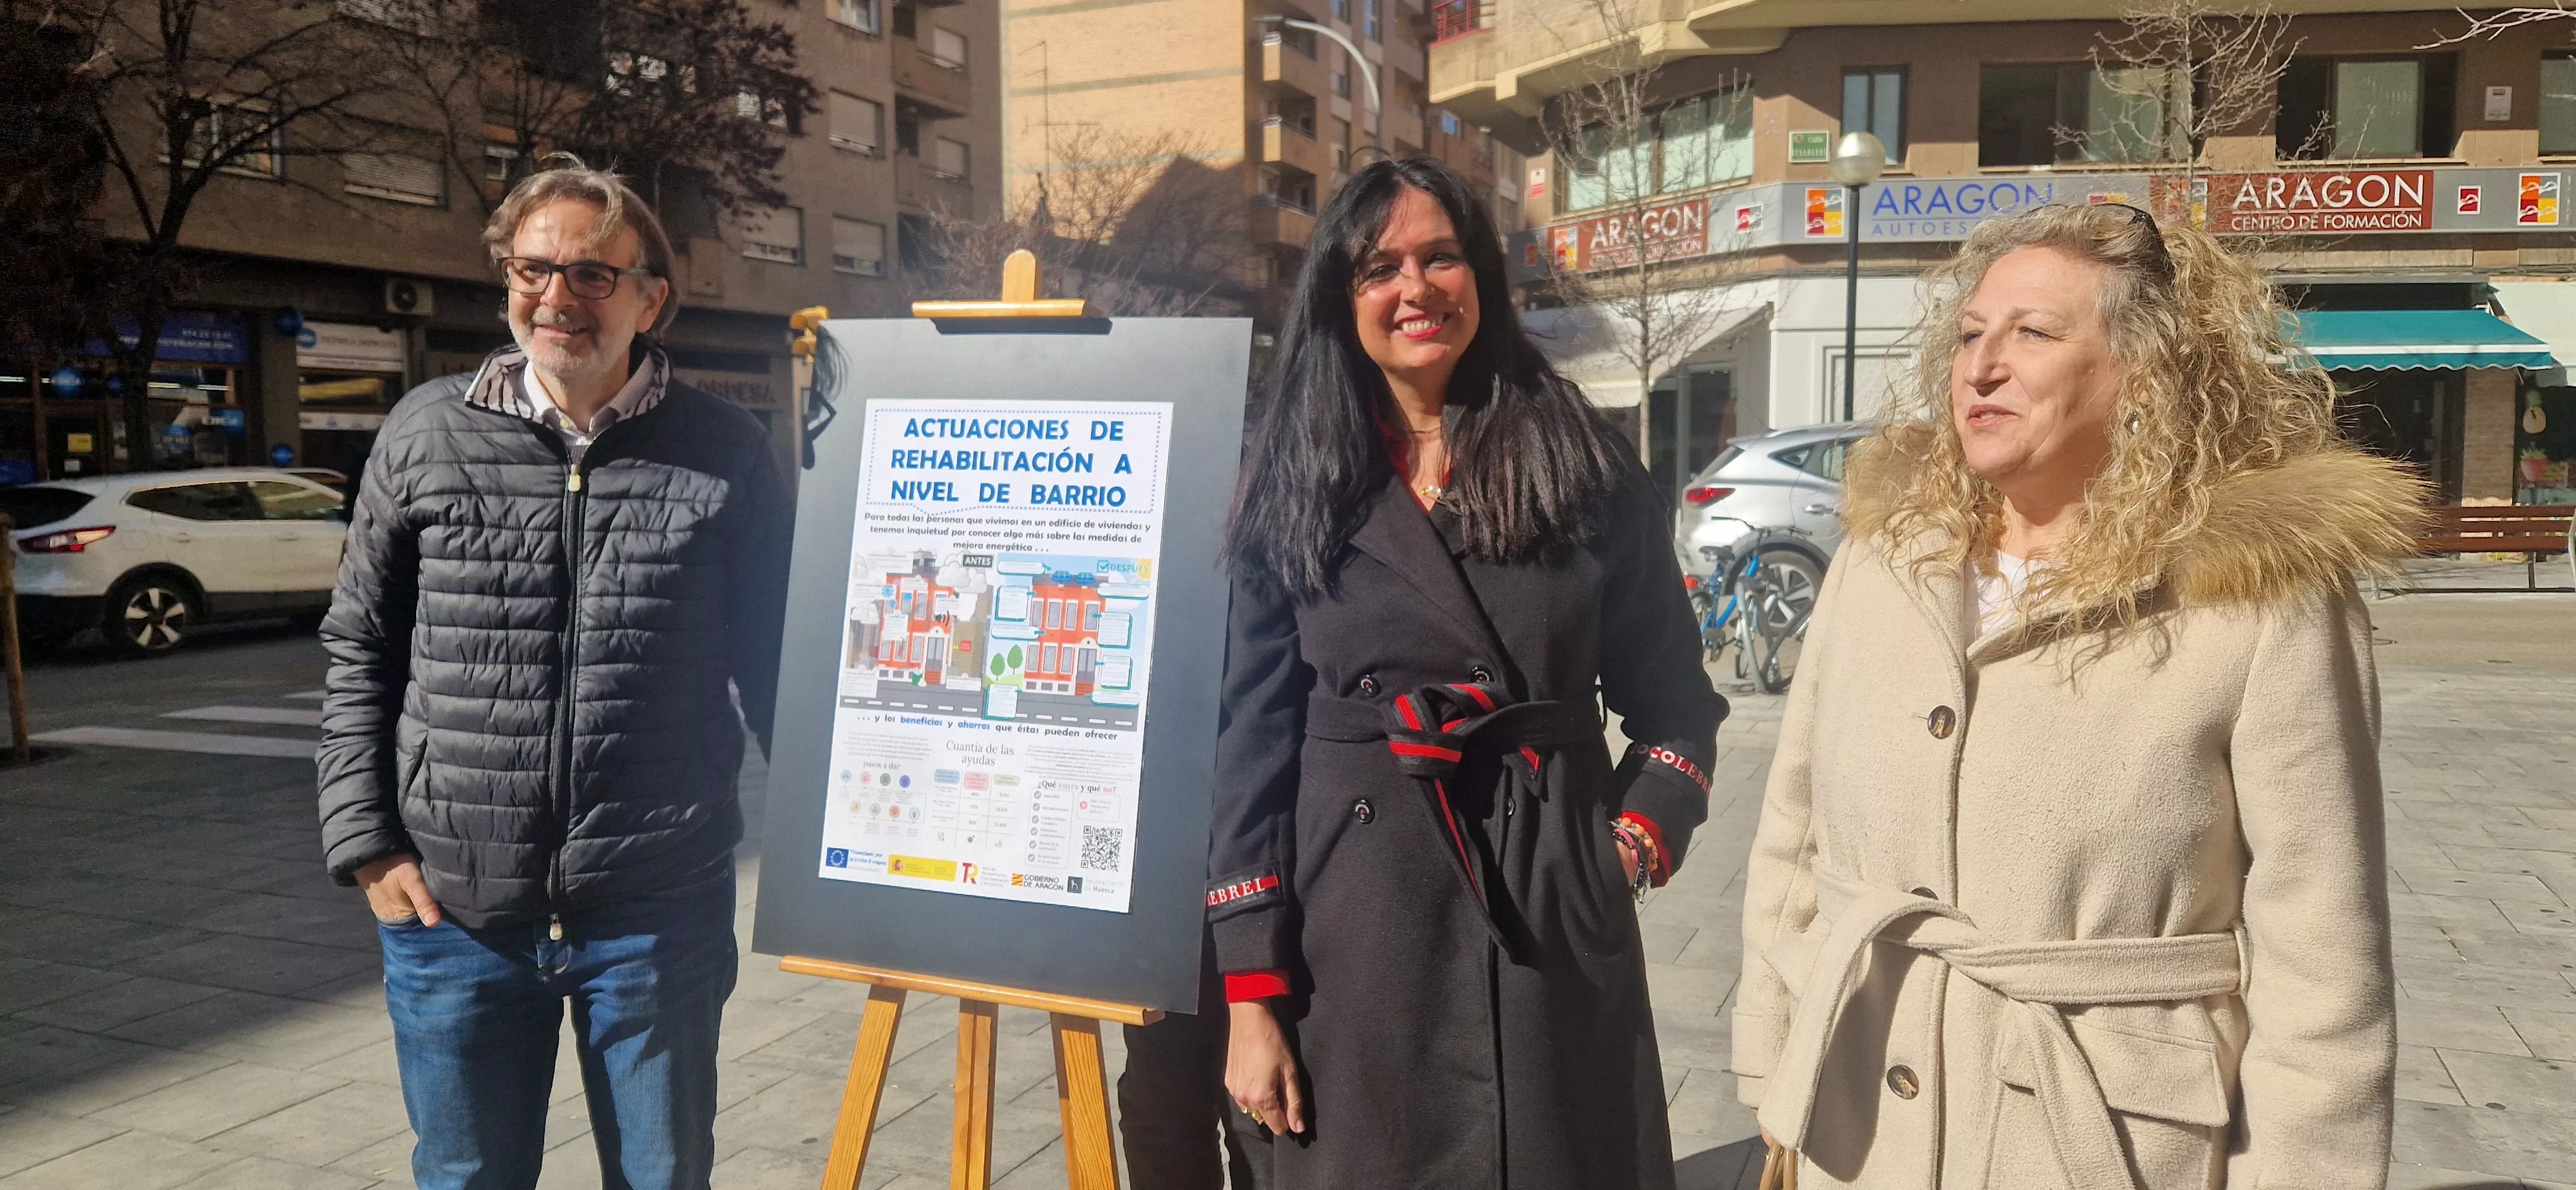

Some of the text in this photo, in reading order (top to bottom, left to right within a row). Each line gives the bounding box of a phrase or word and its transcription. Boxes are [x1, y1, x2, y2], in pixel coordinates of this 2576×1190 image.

[1873, 183, 2053, 216] ARAGON
[2231, 174, 2424, 210] ARAGON
[1590, 201, 1703, 249] ARAGON
[1871, 222, 1980, 236] AUTOES
[2231, 210, 2422, 231] CENTRO DE FORMACIÓN
[904, 418, 1124, 441] ACTUACIONES DE
[891, 446, 1132, 475] REHABILITACIÓN A
[891, 480, 1126, 507] NIVEL DE BARRIO
[864, 513, 885, 521] Para
[887, 513, 909, 522] todas
[913, 514, 923, 522] las
[927, 516, 963, 524] personas
[1048, 518, 1081, 527] edificio
[1084, 520, 1095, 528] de
[1098, 521, 1142, 530] viviendas
[1145, 524, 1151, 532] y
[870, 525, 904, 534] tenemos
[907, 526, 949, 536] inquietud
[1003, 529, 1023, 539] algo
[1026, 531, 1043, 539] más
[1046, 531, 1070, 540] sobre
[1073, 532, 1085, 540] las
[1088, 533, 1128, 542] medidas
[1131, 534, 1142, 543] de
[953, 541, 983, 550] mejora
[986, 542, 1032, 552] energética
[965, 556, 991, 566] ANTES
[885, 714, 895, 722] los
[900, 715, 943, 726] beneficios
[958, 721, 990, 730] ahorros
[1018, 724, 1039, 733] éstas
[1045, 728, 1080, 737] pueden
[1085, 730, 1118, 740] ofrecer
[946, 740, 1014, 755] Cuantía de las
[961, 755, 996, 767] ayudas
[1037, 780, 1057, 788] ¿Qué
[1081, 784, 1086, 793] y
[1087, 784, 1101, 793] qué
[1024, 874, 1059, 883] GOBIERNO
